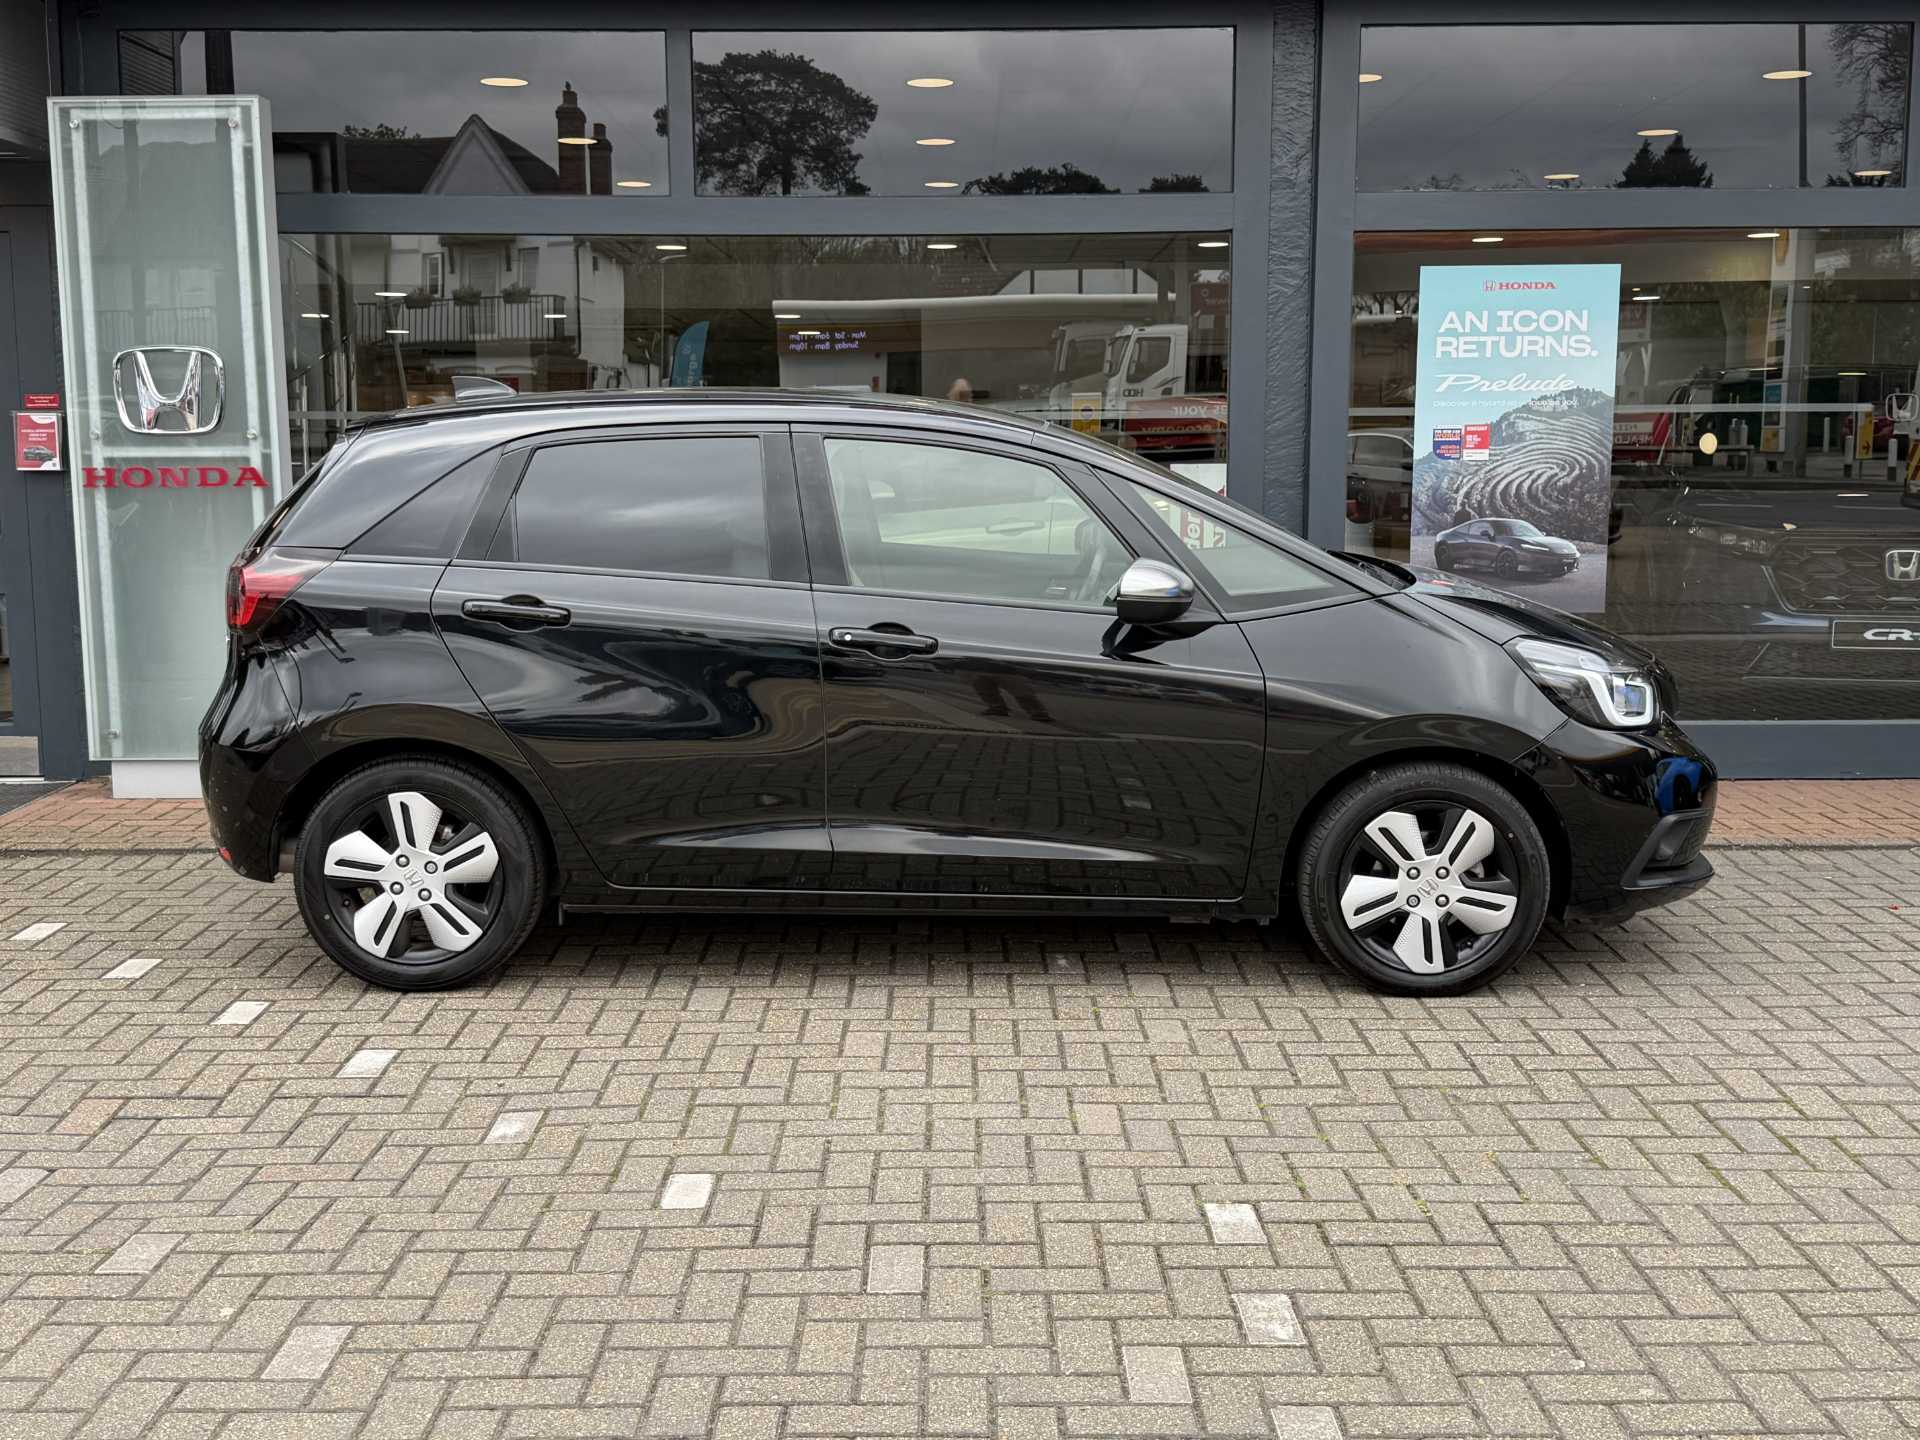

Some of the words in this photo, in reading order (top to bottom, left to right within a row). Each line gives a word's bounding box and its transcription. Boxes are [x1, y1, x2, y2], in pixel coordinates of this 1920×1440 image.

[1499, 281, 1557, 290] HONDA
[1438, 310, 1488, 333] AN
[1496, 309, 1588, 333] ICON
[1434, 335, 1599, 358] RETURNS.
[1434, 372, 1579, 392] Prelude
[81, 466, 270, 489] HONDA
